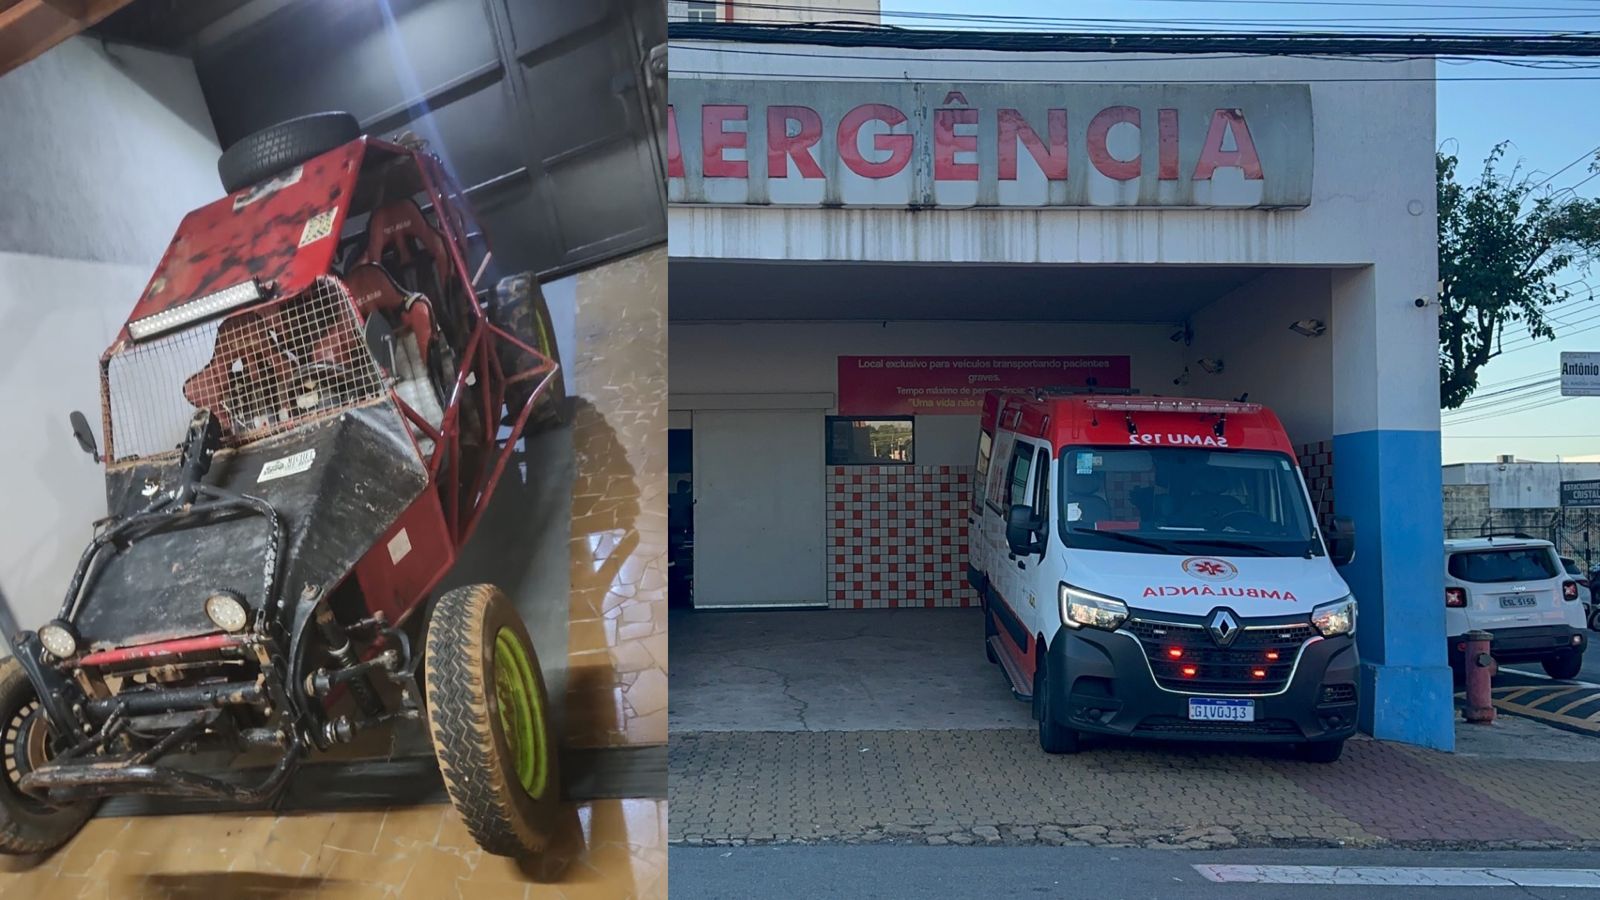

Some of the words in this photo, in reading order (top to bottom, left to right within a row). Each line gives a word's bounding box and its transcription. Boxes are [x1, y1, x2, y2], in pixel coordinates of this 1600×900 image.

[858, 359, 883, 368] Local
[885, 359, 927, 368] exclusivo
[929, 361, 950, 370] para
[952, 359, 991, 368] veículos
[993, 359, 1062, 370] transportando
[1063, 359, 1110, 370] pacientes
[896, 386, 924, 396] Tempo
[926, 385, 958, 395] máximo
[959, 385, 970, 395] de
[935, 398, 956, 408] vida
[957, 398, 976, 408] não
[1511, 584, 1526, 592] Jeep
